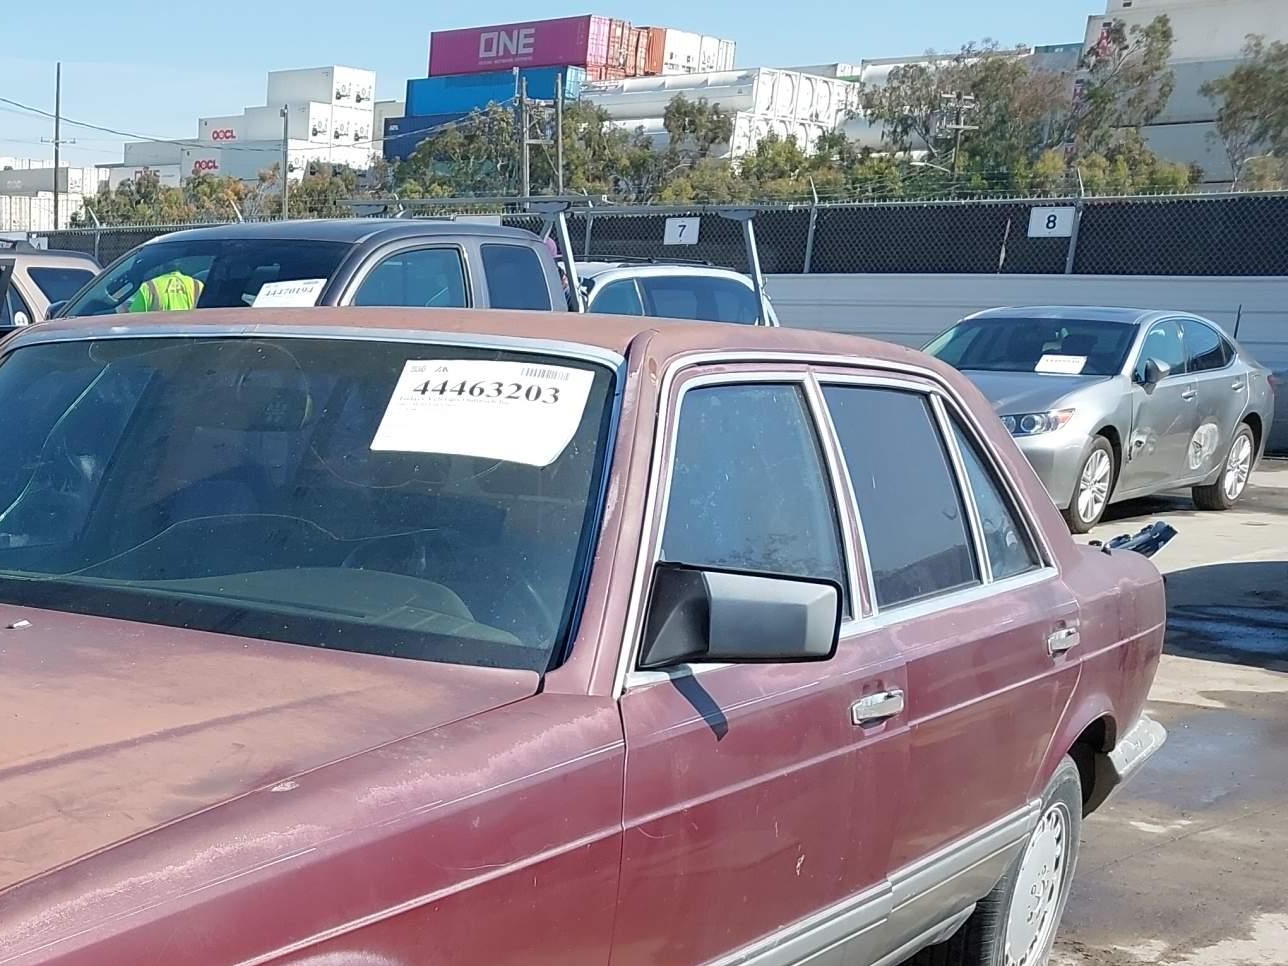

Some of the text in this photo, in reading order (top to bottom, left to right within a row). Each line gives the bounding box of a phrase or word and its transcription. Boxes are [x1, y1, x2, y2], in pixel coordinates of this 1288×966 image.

[479, 28, 535, 57] ONE
[212, 129, 236, 140] OOCL
[1046, 214, 1057, 230] 8
[678, 224, 687, 238] 7
[412, 379, 560, 404] 44463203
